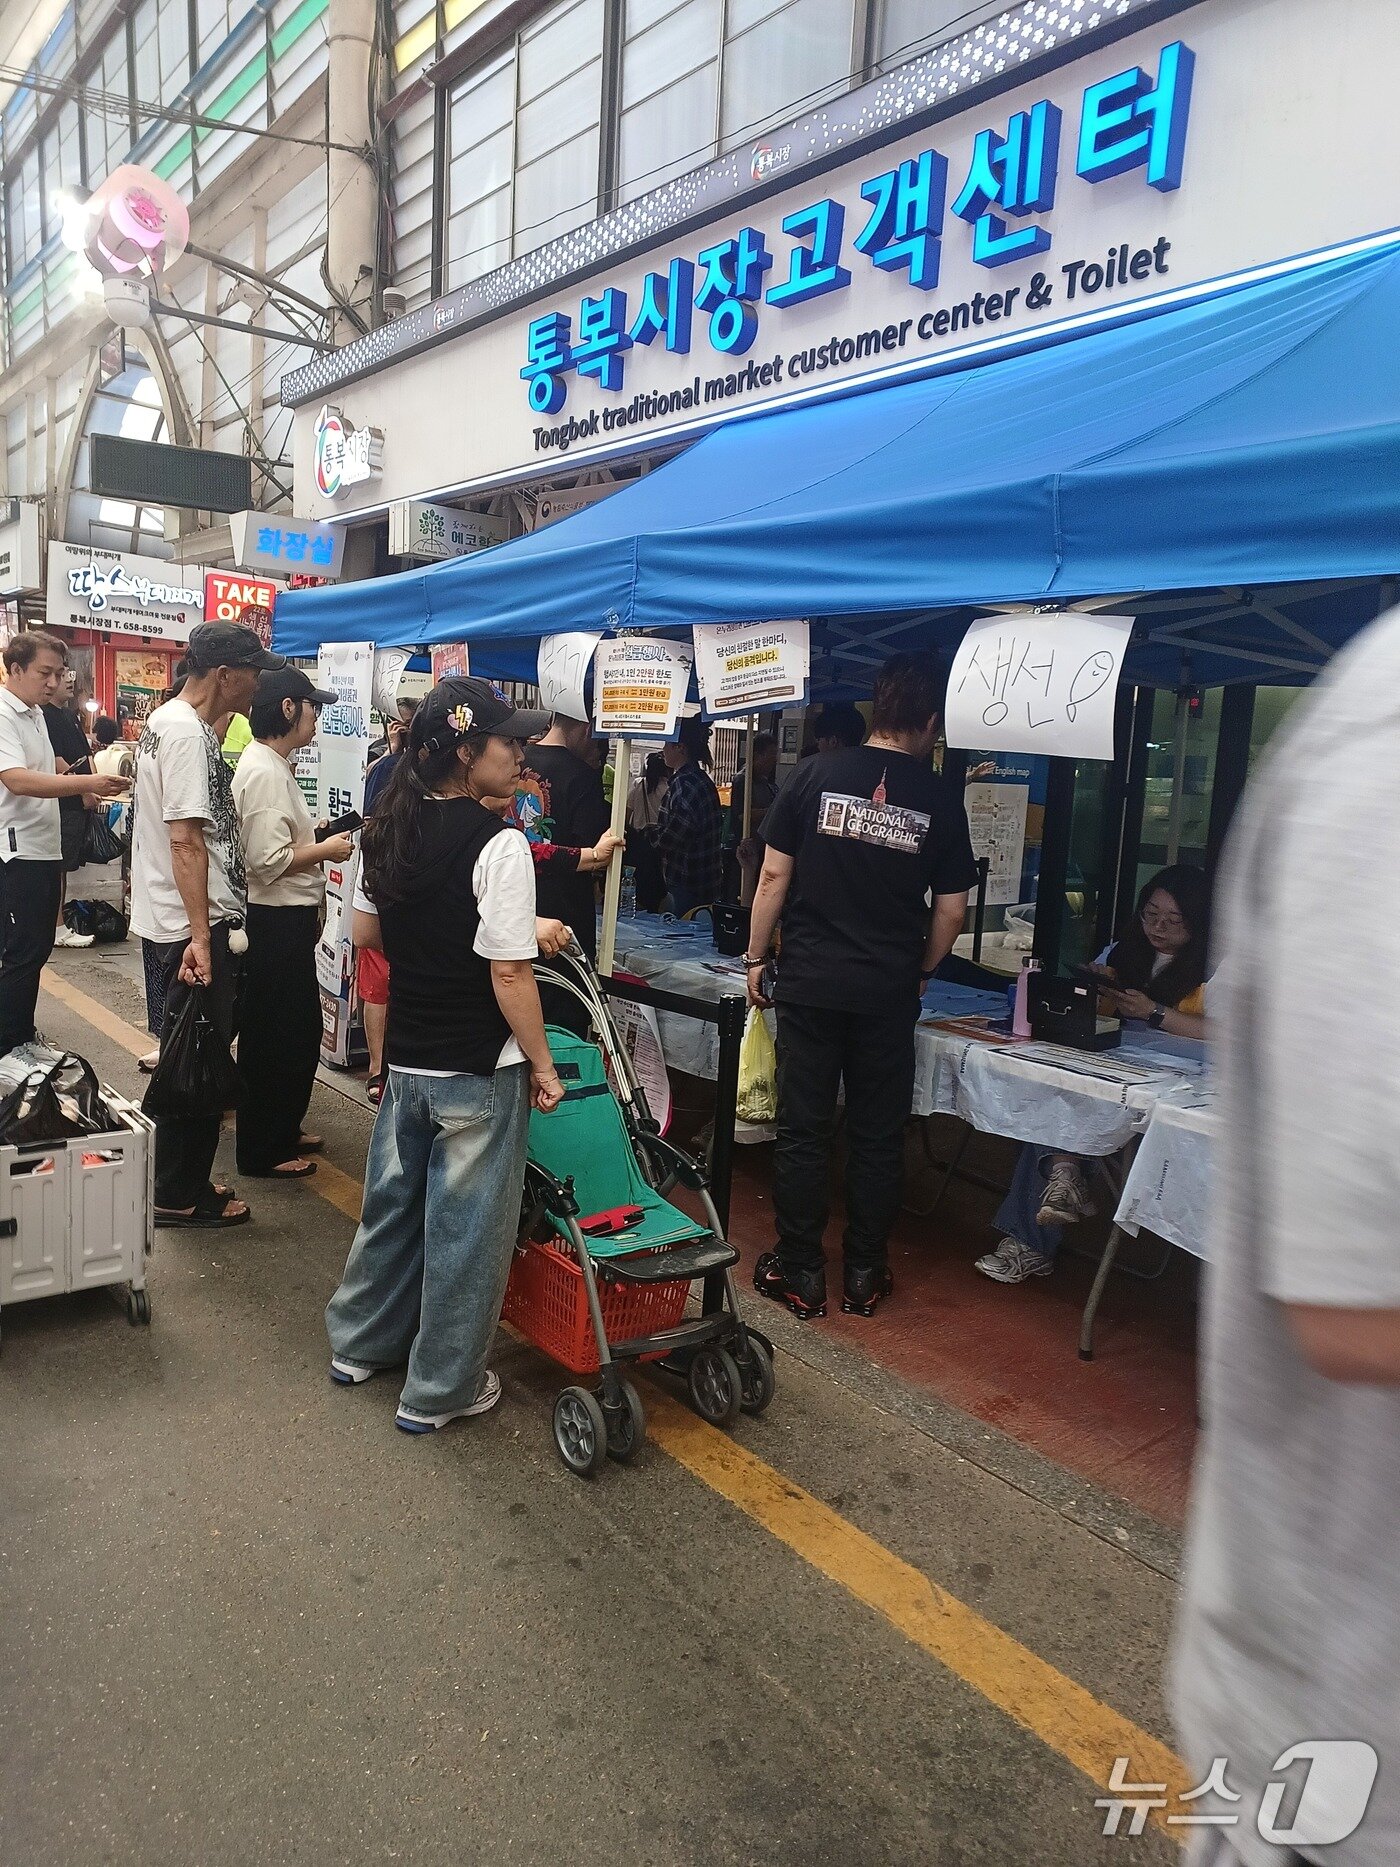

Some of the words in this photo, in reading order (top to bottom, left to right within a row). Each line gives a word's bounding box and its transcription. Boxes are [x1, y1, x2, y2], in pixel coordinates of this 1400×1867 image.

[533, 409, 600, 450] Tongbok
[602, 377, 700, 431] traditional
[704, 354, 783, 403] market
[787, 317, 913, 378] customer
[917, 286, 1020, 340] center
[1025, 272, 1053, 310] &
[1062, 236, 1171, 299] Toilet
[324, 430, 369, 474] 통복시장
[257, 527, 333, 565] 화장실
[213, 580, 270, 606] TAKE
[70, 614, 112, 628] 통복시장점
[114, 621, 121, 629] T.
[124, 622, 163, 634] 658-8599
[716, 643, 737, 658] 당신의
[754, 637, 761, 648] 말
[761, 633, 787, 647] 한마디,
[726, 659, 744, 671] 당신의
[744, 650, 778, 667] 품격입니다.
[626, 668, 636, 678] 1인
[636, 668, 655, 678] 2만원
[656, 669, 672, 679] 한도
[958, 637, 1054, 728] 생선
[639, 689, 656, 697] 1만원
[638, 702, 654, 711] 2만원
[995, 766, 1016, 777] English
[1017, 769, 1030, 778] map
[851, 805, 907, 830] NATIONAL
[847, 818, 920, 845] GEOGRAPHIC
